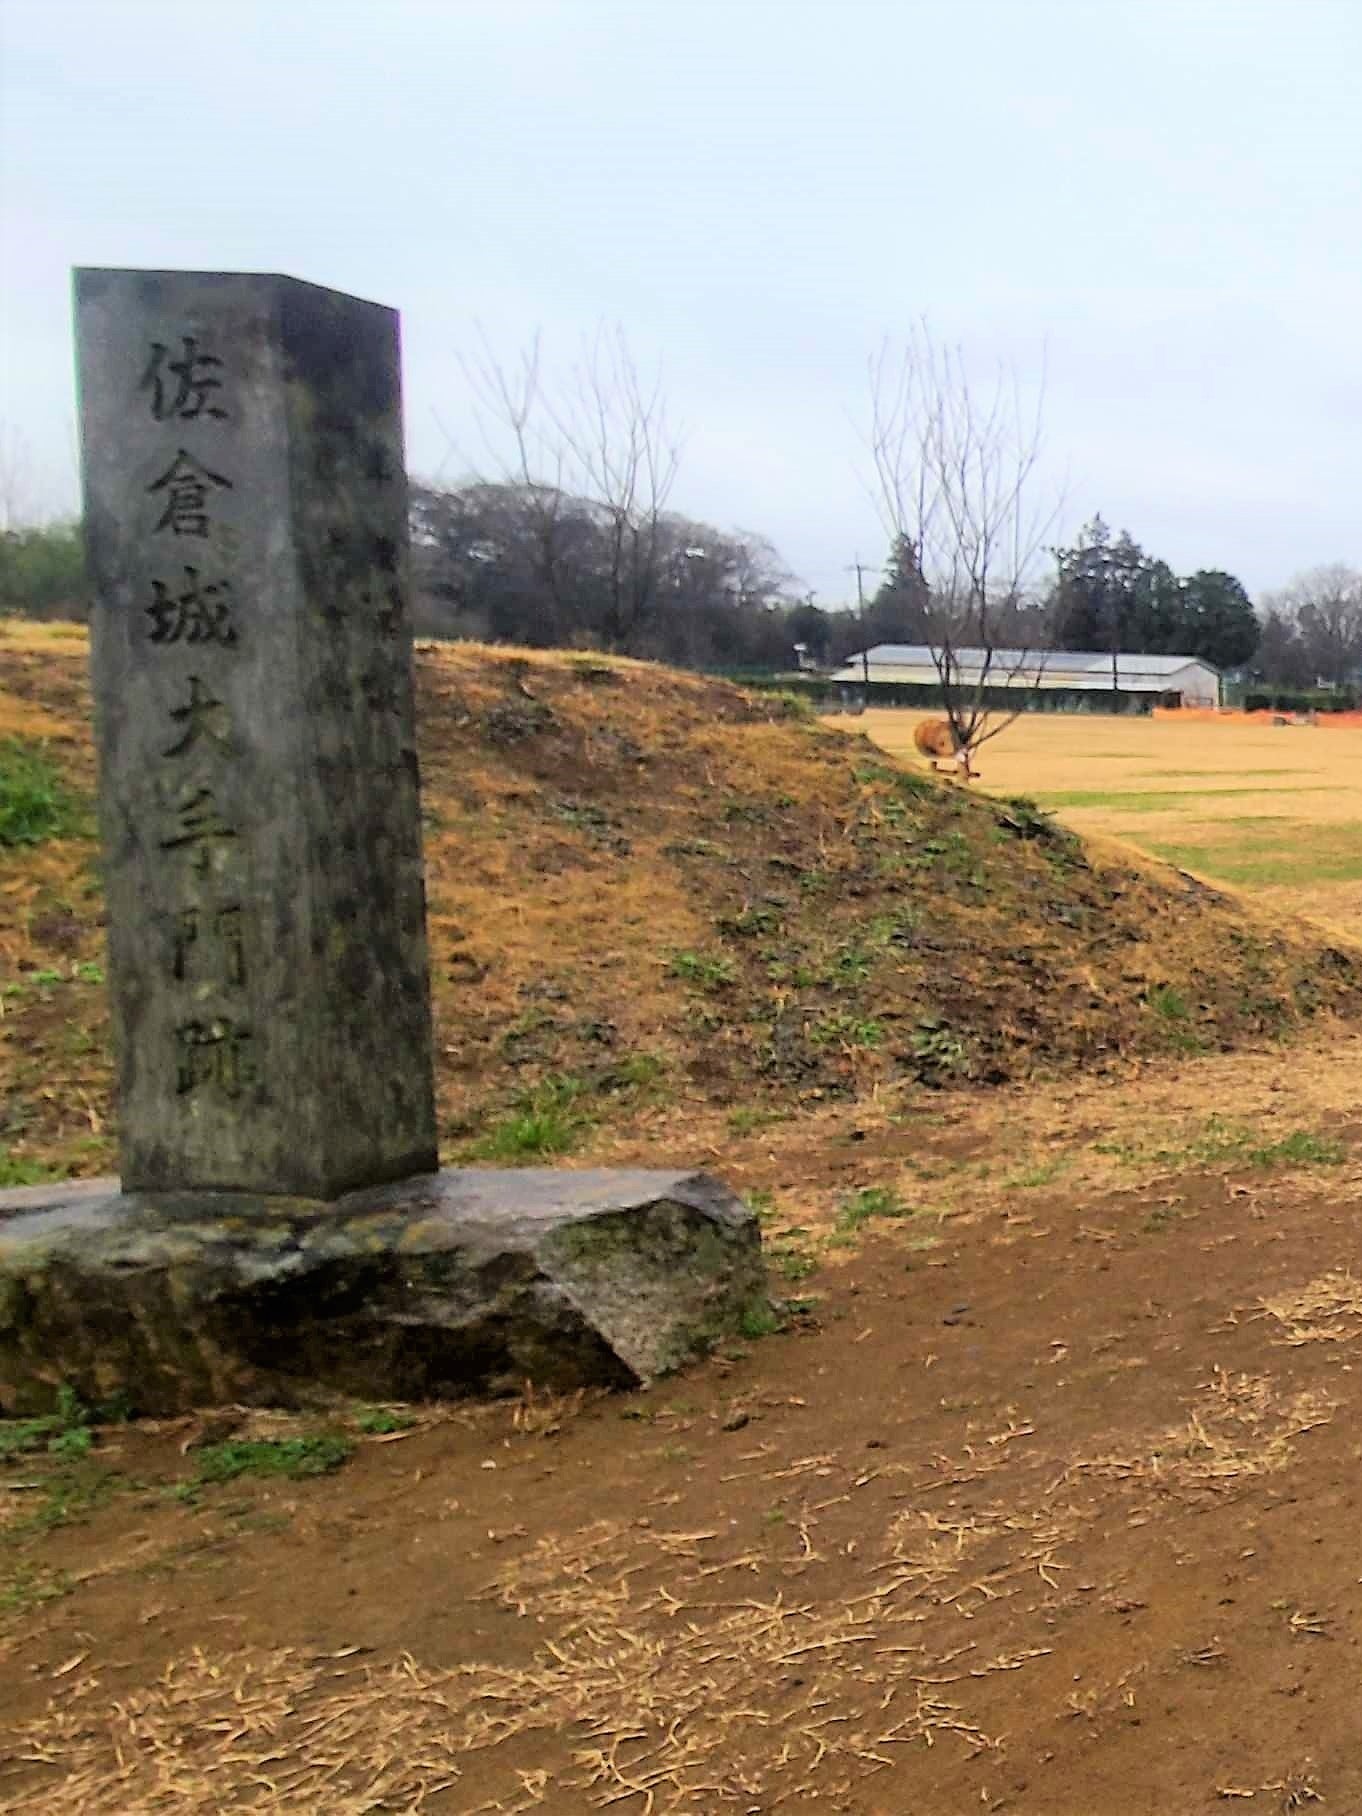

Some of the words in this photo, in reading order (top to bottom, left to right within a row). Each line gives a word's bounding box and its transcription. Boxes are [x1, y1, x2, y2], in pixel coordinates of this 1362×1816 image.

[140, 338, 258, 1098] 佐倉城大手門跡
